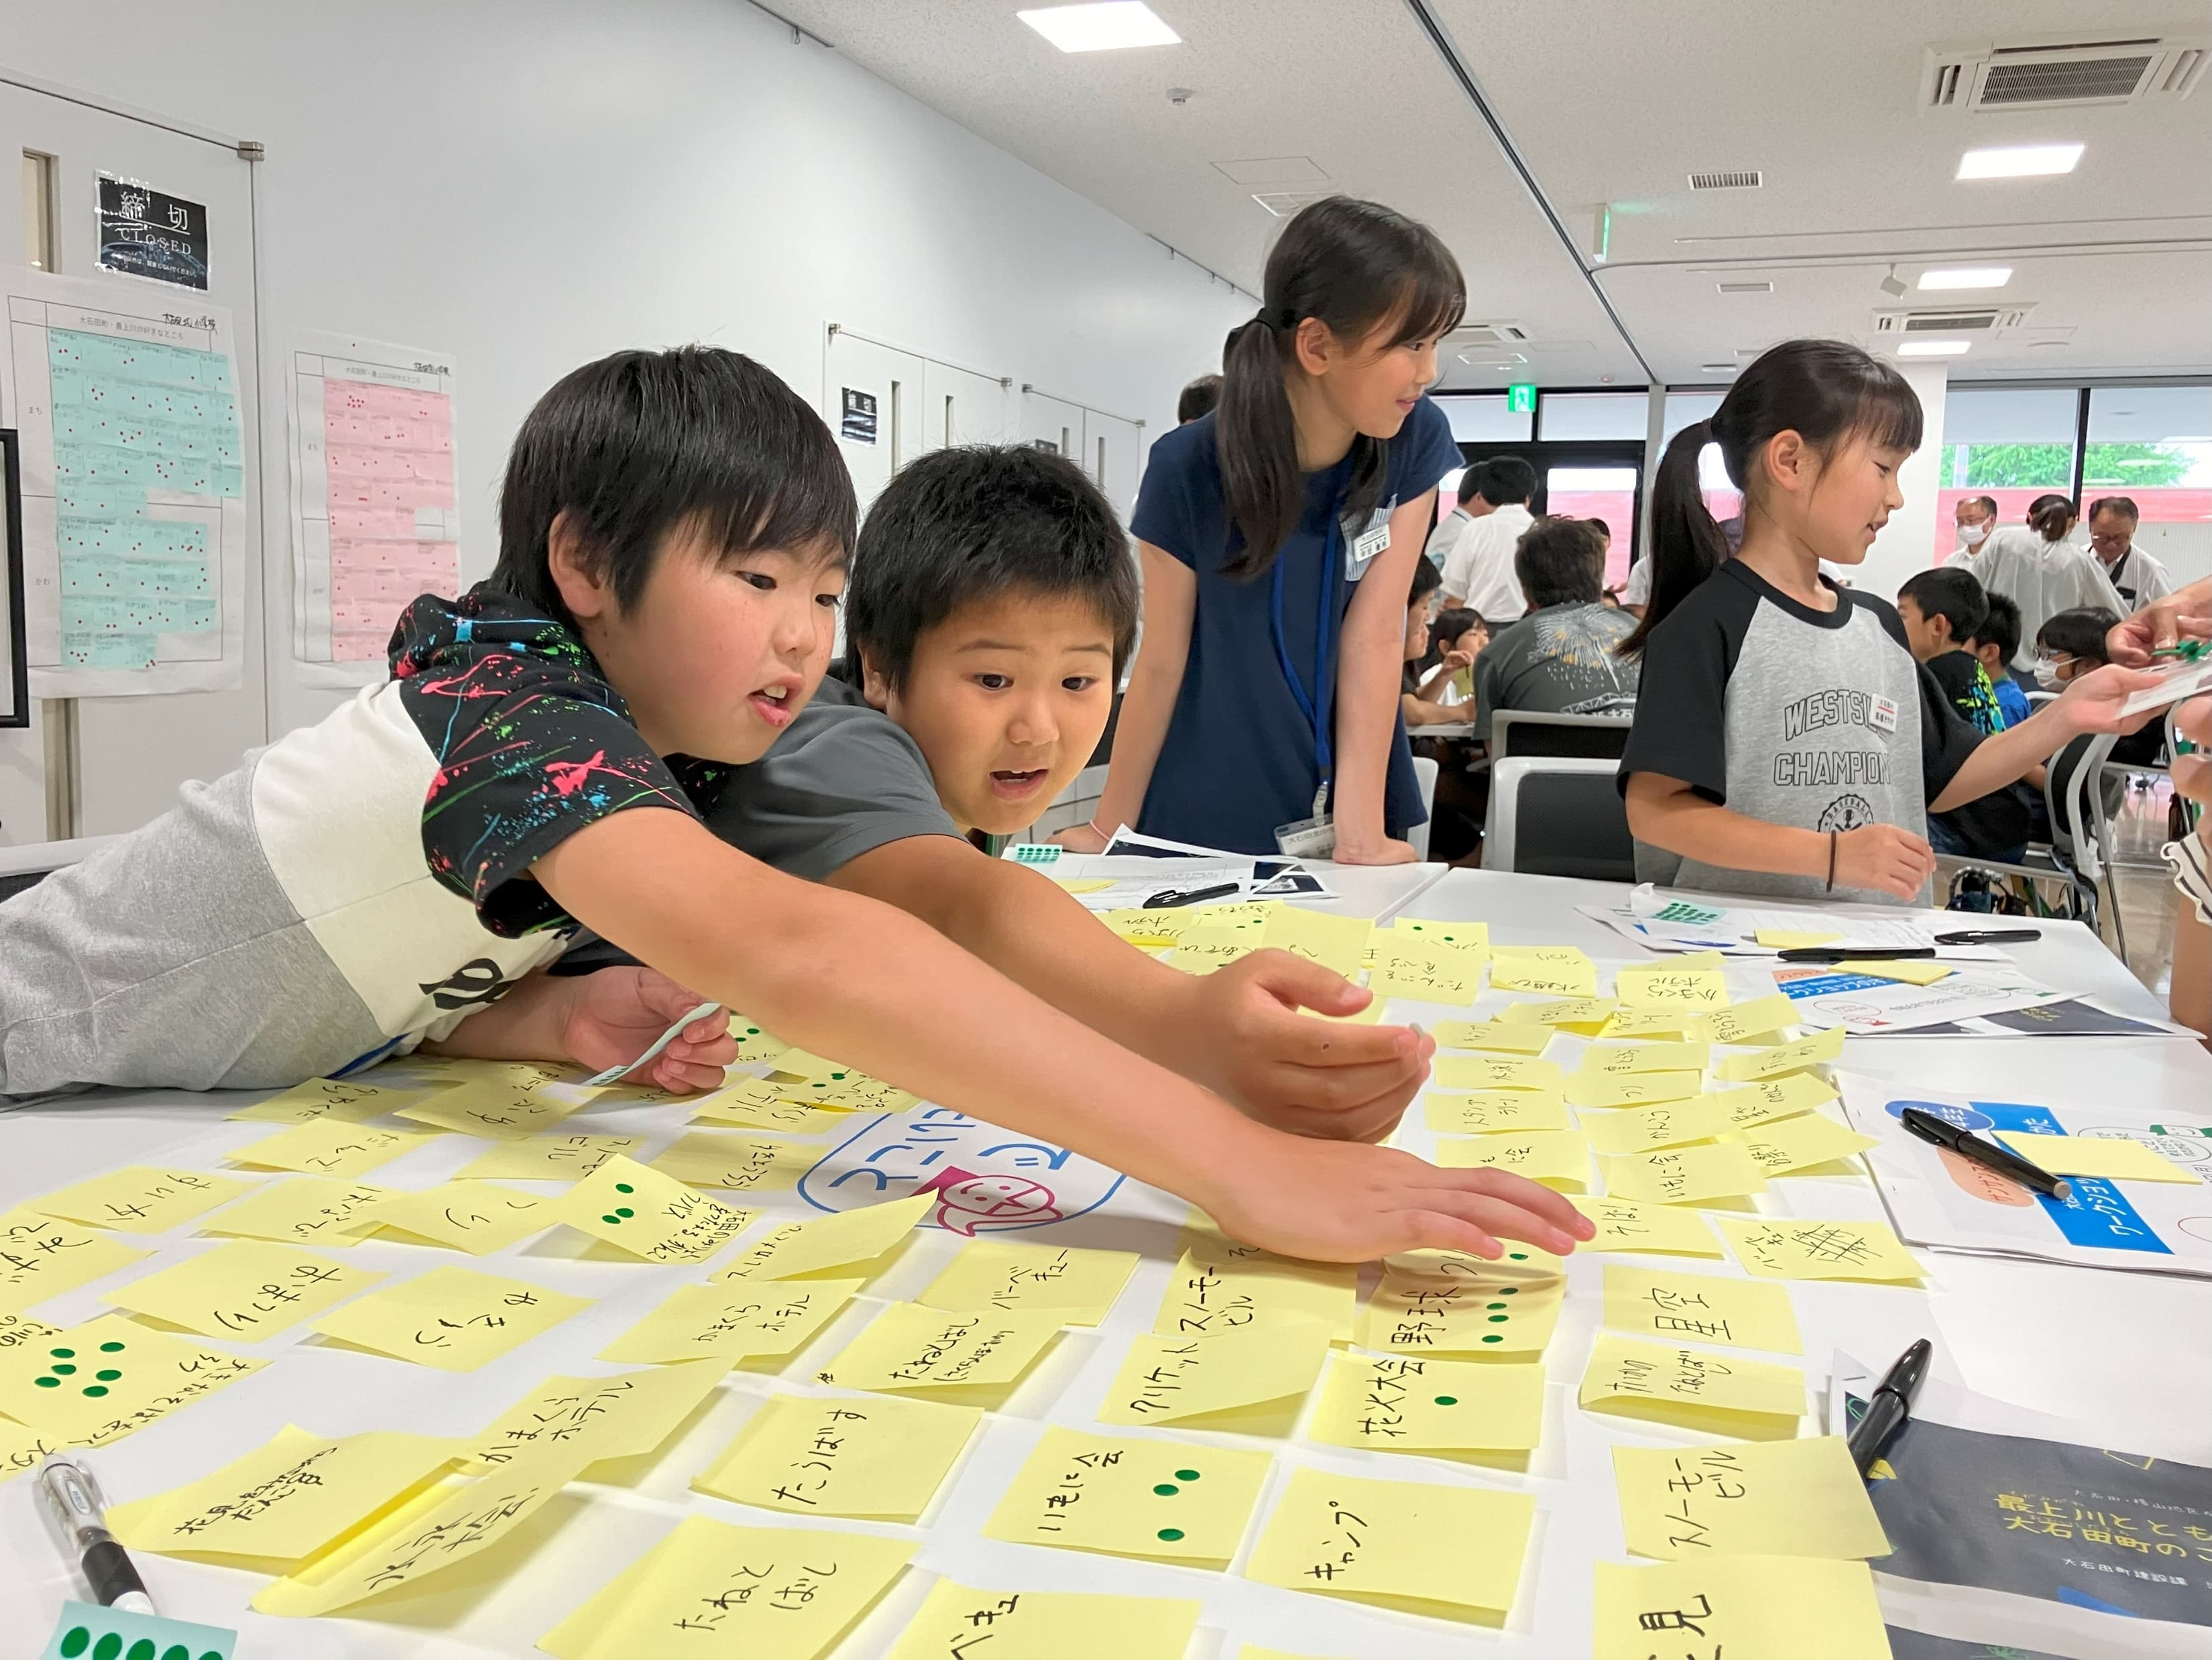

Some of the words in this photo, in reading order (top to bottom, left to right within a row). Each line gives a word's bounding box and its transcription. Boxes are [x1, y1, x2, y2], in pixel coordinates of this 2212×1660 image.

[120, 229, 192, 255] CLOSED
[1784, 689, 1887, 742] WESTSI
[1773, 751, 1891, 786] CHAMPION
[1826, 798, 1871, 818] BASEBALL
[1179, 943, 1265, 958] あそび
[1647, 984, 1718, 1002] かまくら
[1648, 976, 1703, 988] ホテル
[105, 1173, 213, 1222] すいか
[1647, 1152, 1686, 1198] いもに会
[445, 1200, 540, 1230] つり
[990, 1264, 1033, 1311] バーベ
[1031, 1248, 1069, 1283] キュー
[213, 1265, 344, 1331] おまつり
[756, 1294, 811, 1333] ホテル
[1178, 1266, 1224, 1332] スノーモー
[1216, 1294, 1256, 1328] ビル
[1390, 1285, 1464, 1346] 野球
[1641, 1287, 1733, 1342] 星空
[691, 1304, 762, 1342] かまくら
[550, 1380, 636, 1442] ホテル
[1356, 1358, 1427, 1437] 花火大会
[478, 1396, 581, 1464] かまくら
[1037, 1449, 1124, 1532] いもに会
[1700, 1449, 1747, 1499] ビル
[1664, 1458, 1712, 1548] スノーモー
[1303, 1500, 1369, 1582] キャンプ
[672, 1563, 776, 1631] たねと
